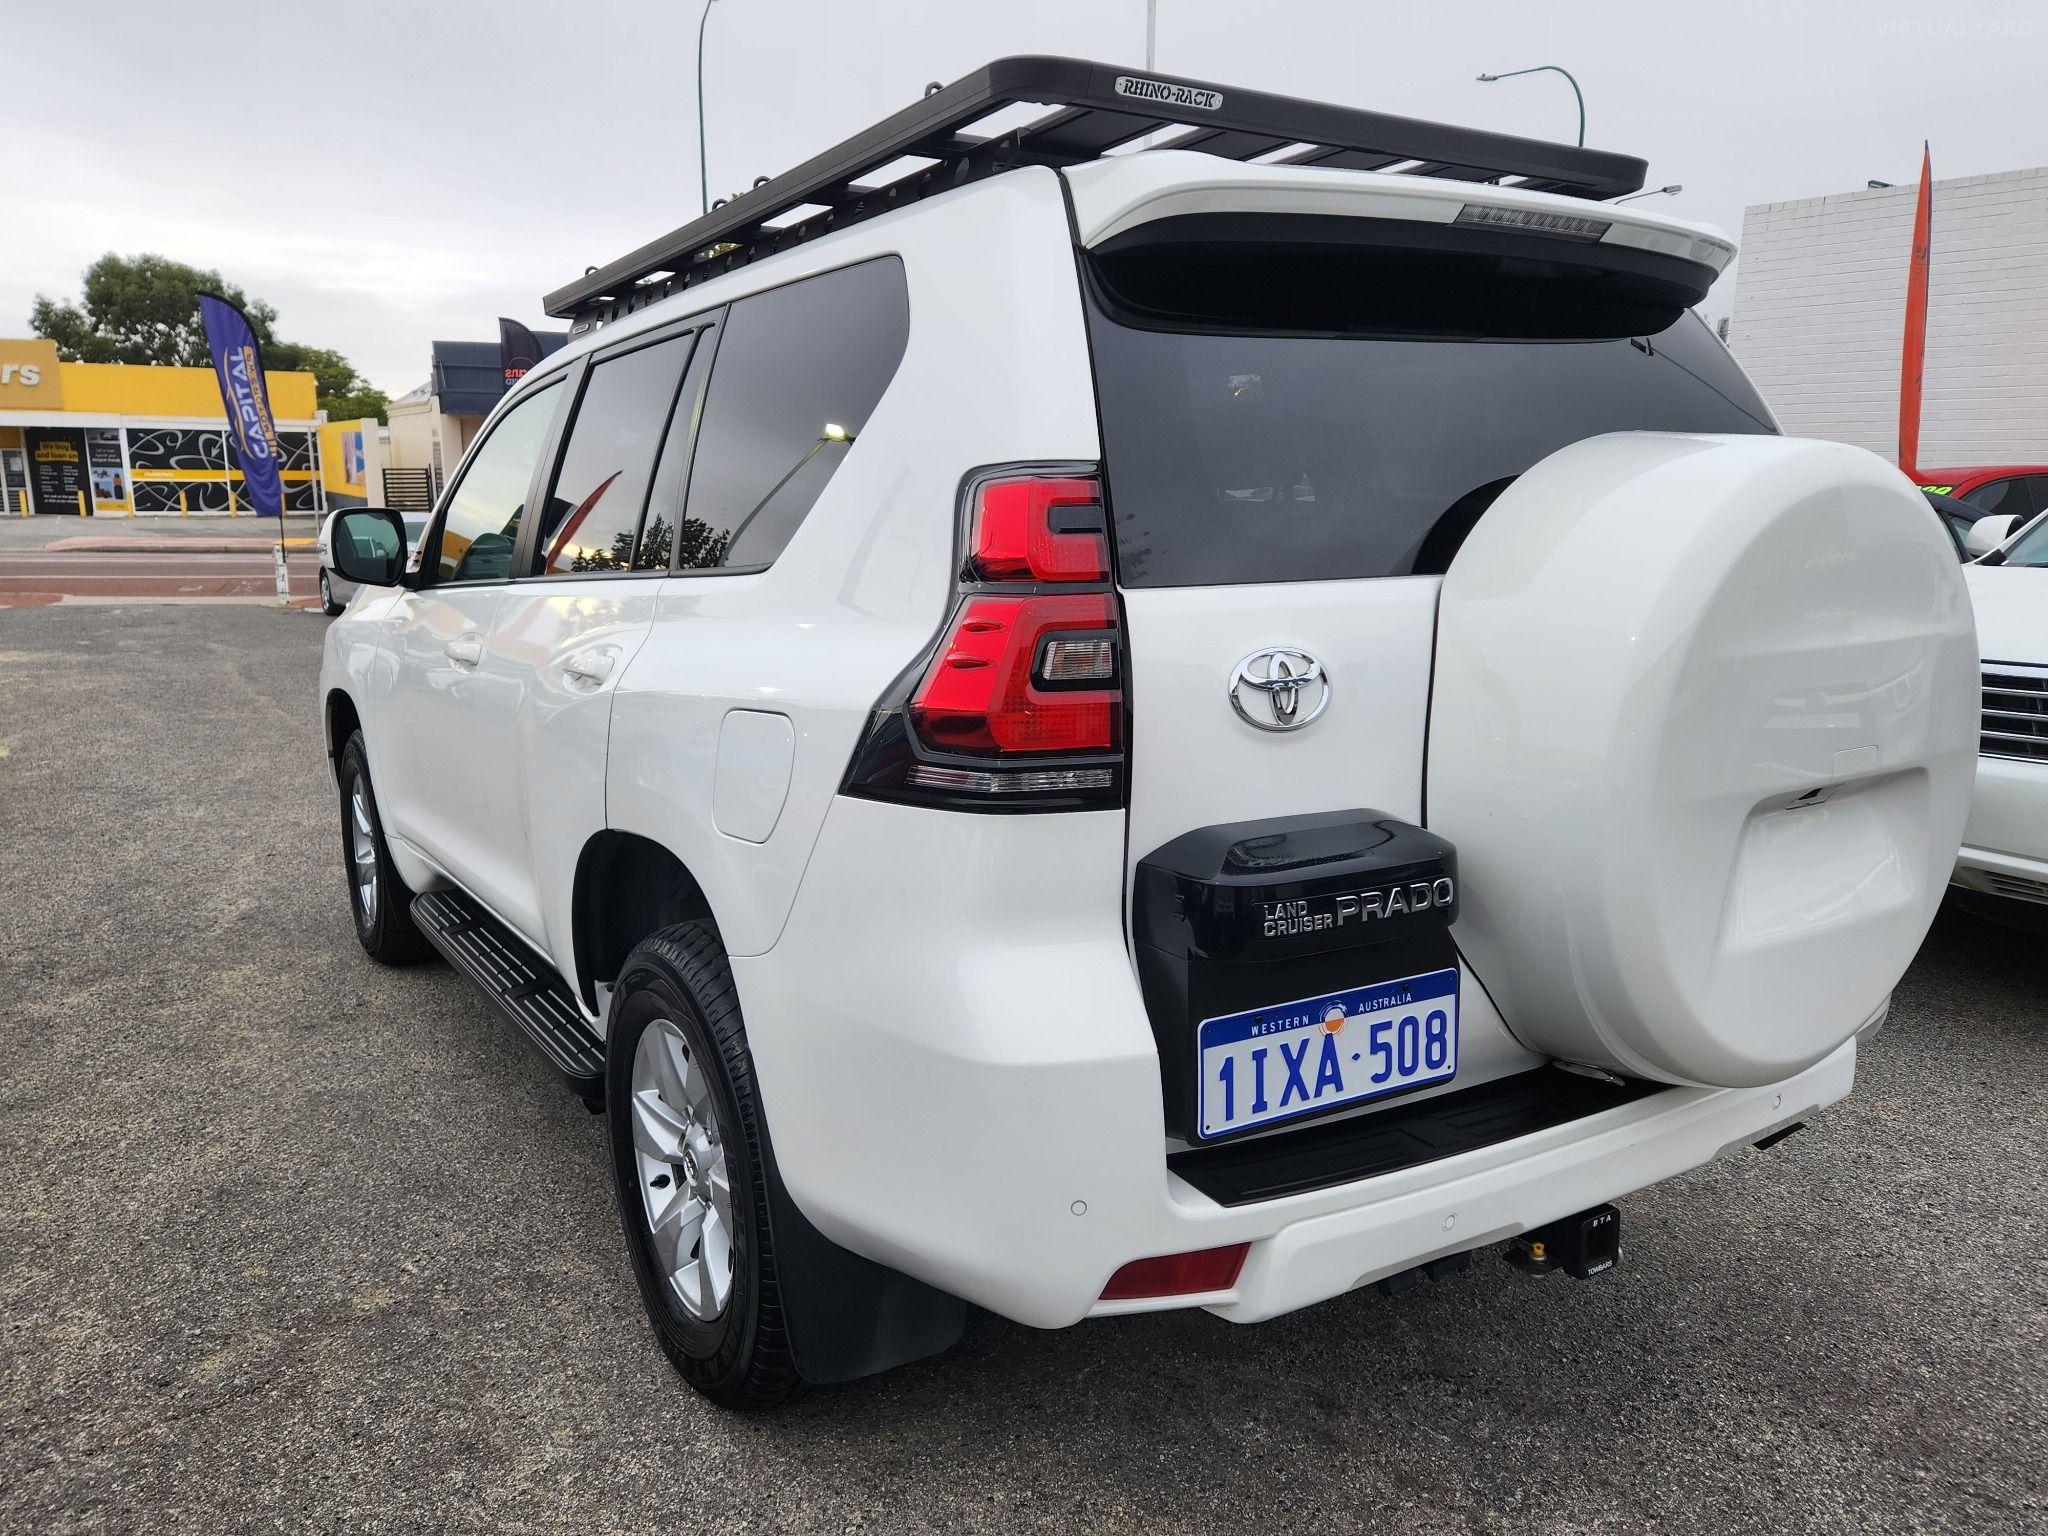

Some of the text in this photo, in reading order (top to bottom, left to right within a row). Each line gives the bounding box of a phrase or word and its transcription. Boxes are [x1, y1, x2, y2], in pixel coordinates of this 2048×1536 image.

[1122, 78, 1216, 108] RHINO-RACK
[229, 346, 270, 459] CAPITAL
[250, 379, 272, 434] MOTORS
[1264, 877, 1455, 926] LAND PRADO
[1263, 914, 1333, 937] CRUISER
[1251, 991, 1413, 1037] WESTERN AUSTRALIA
[1588, 1260, 1612, 1276] TOWBARS
